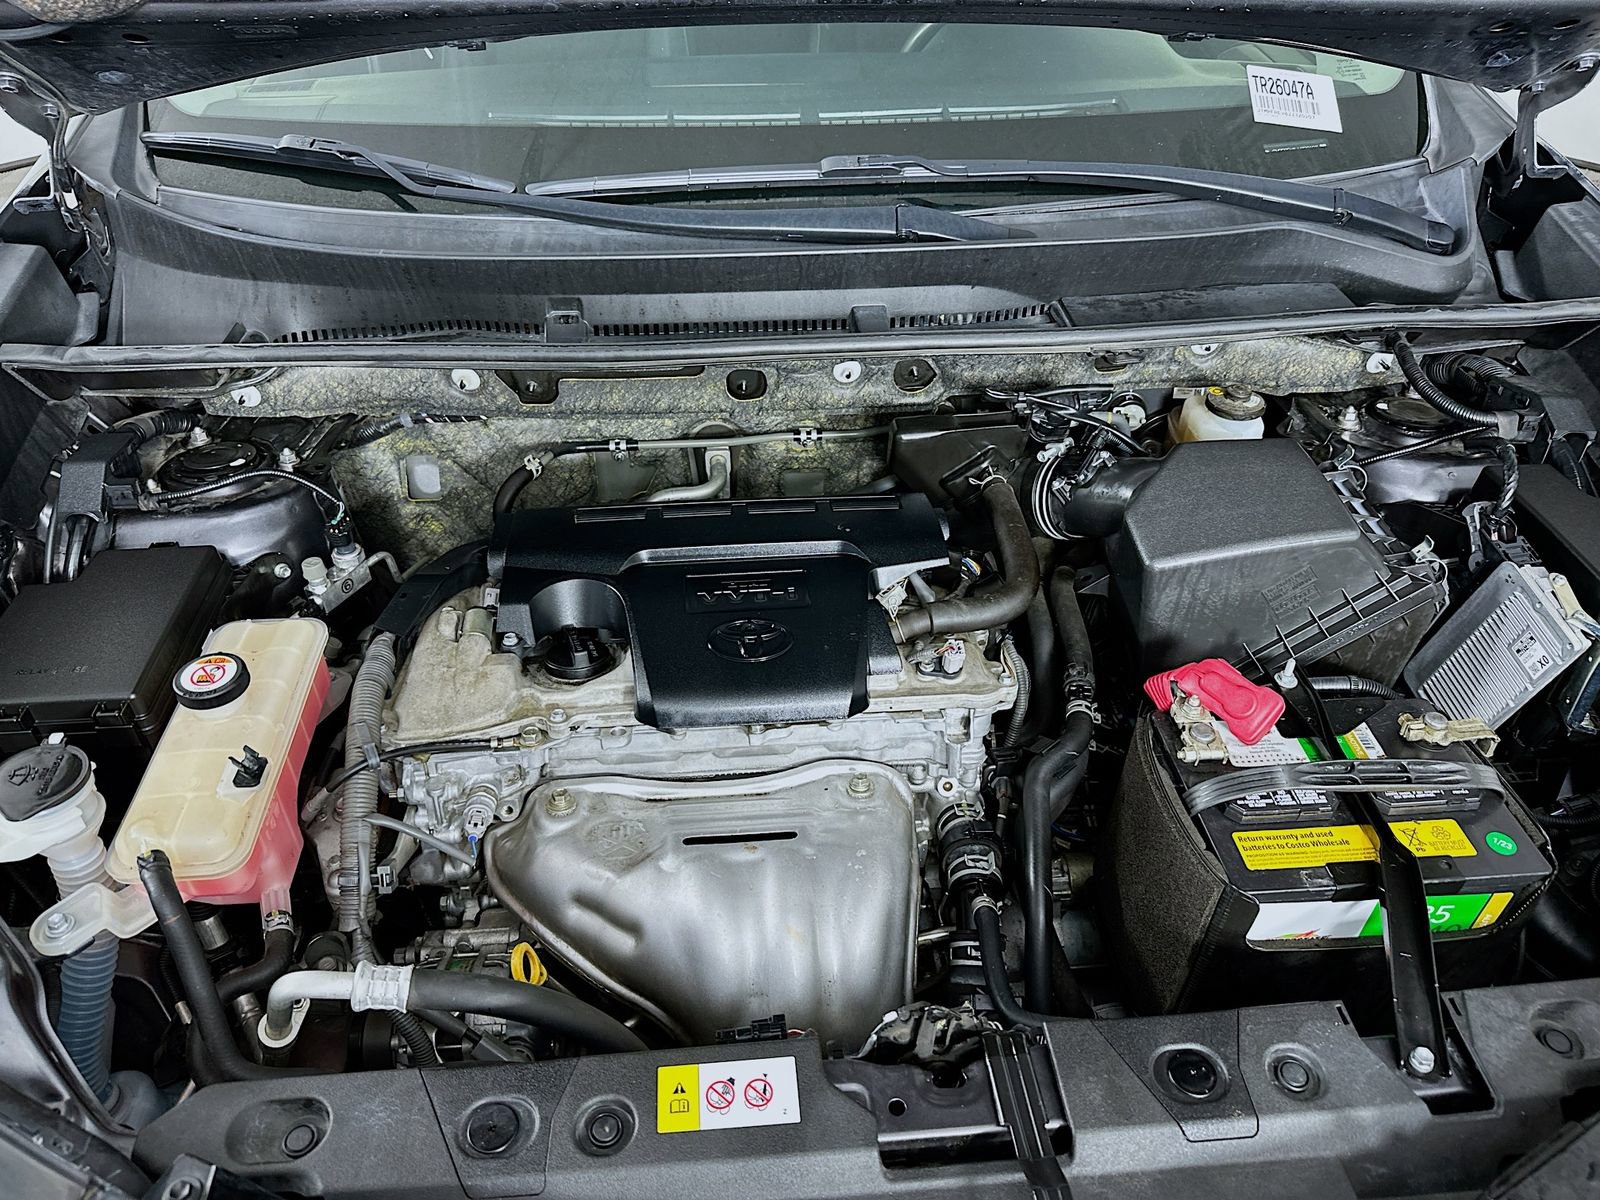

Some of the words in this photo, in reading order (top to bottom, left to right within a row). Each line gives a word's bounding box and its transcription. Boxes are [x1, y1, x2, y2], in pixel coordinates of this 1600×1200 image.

[1252, 75, 1314, 100] TR26047A
[1316, 830, 1333, 838] used
[1242, 843, 1276, 852] batteries
[1286, 841, 1310, 849] Costco
[1310, 838, 1350, 847] Wholesale
[1493, 837, 1513, 850] 1/23
